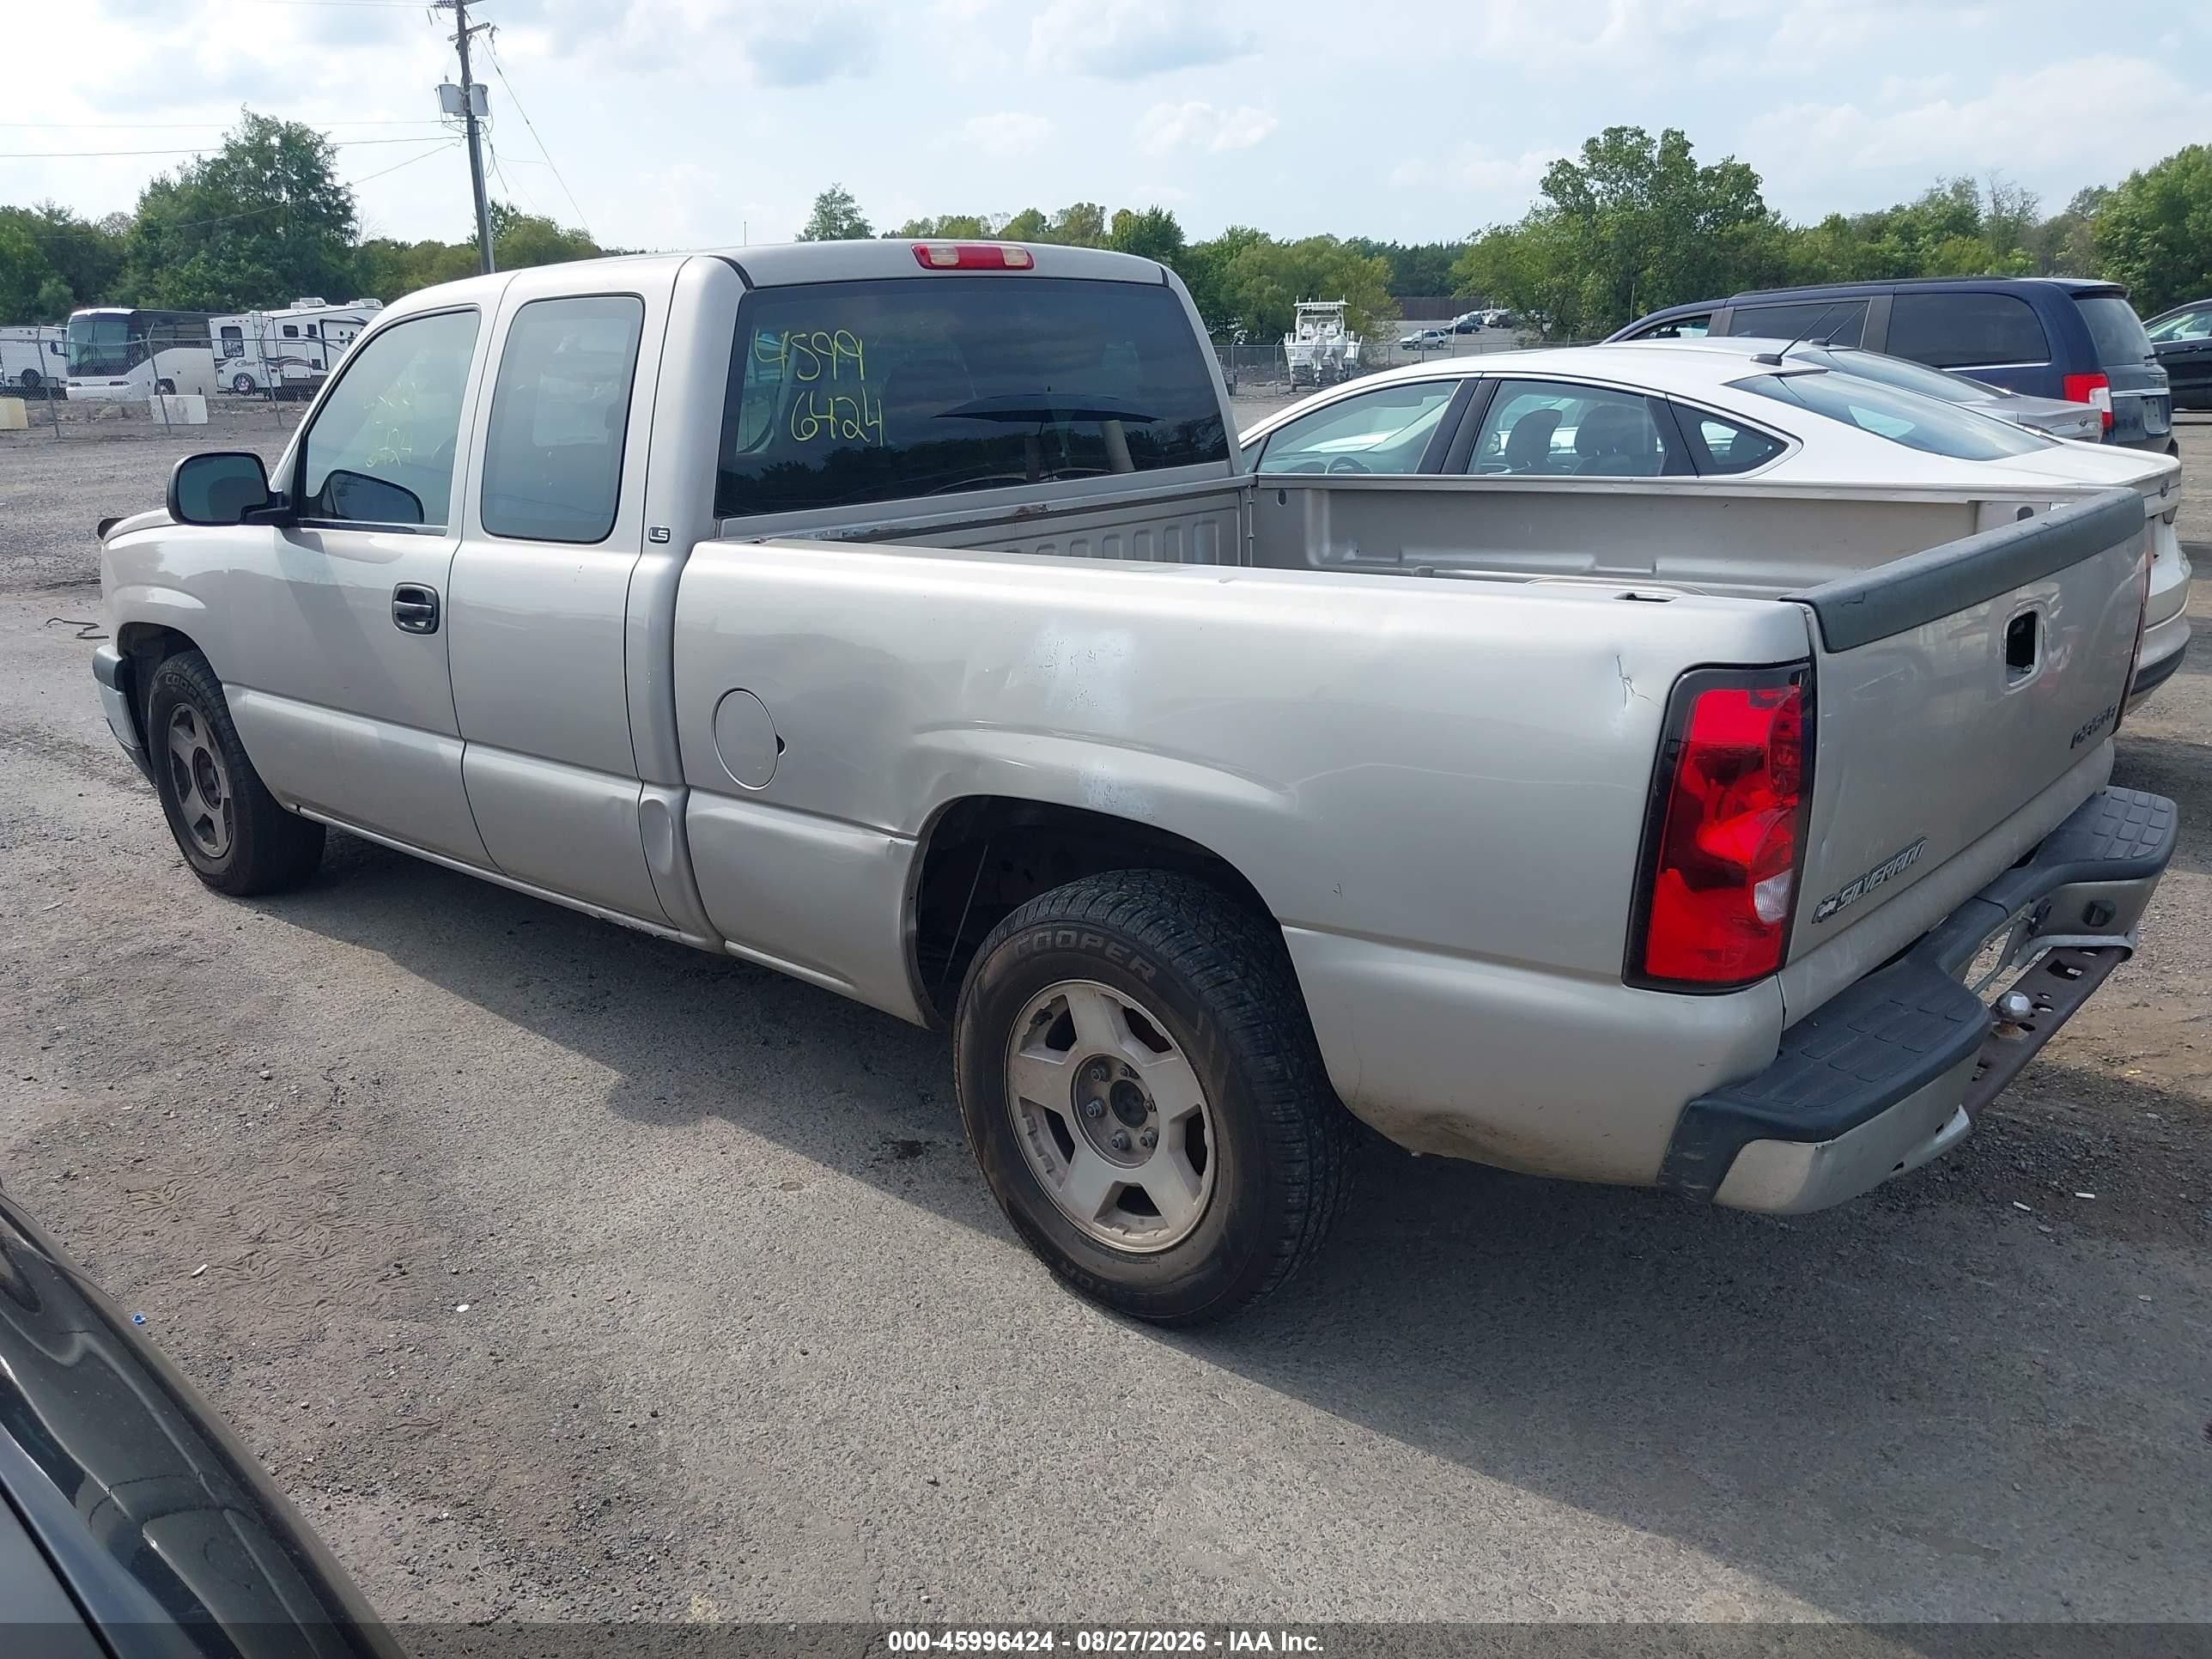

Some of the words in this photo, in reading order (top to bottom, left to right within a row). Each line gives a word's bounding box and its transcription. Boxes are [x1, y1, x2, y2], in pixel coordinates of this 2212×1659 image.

[755, 329, 866, 380] 4599
[791, 386, 884, 447] 6424
[649, 528, 669, 541] LS
[1014, 929, 1157, 983] COOPER
